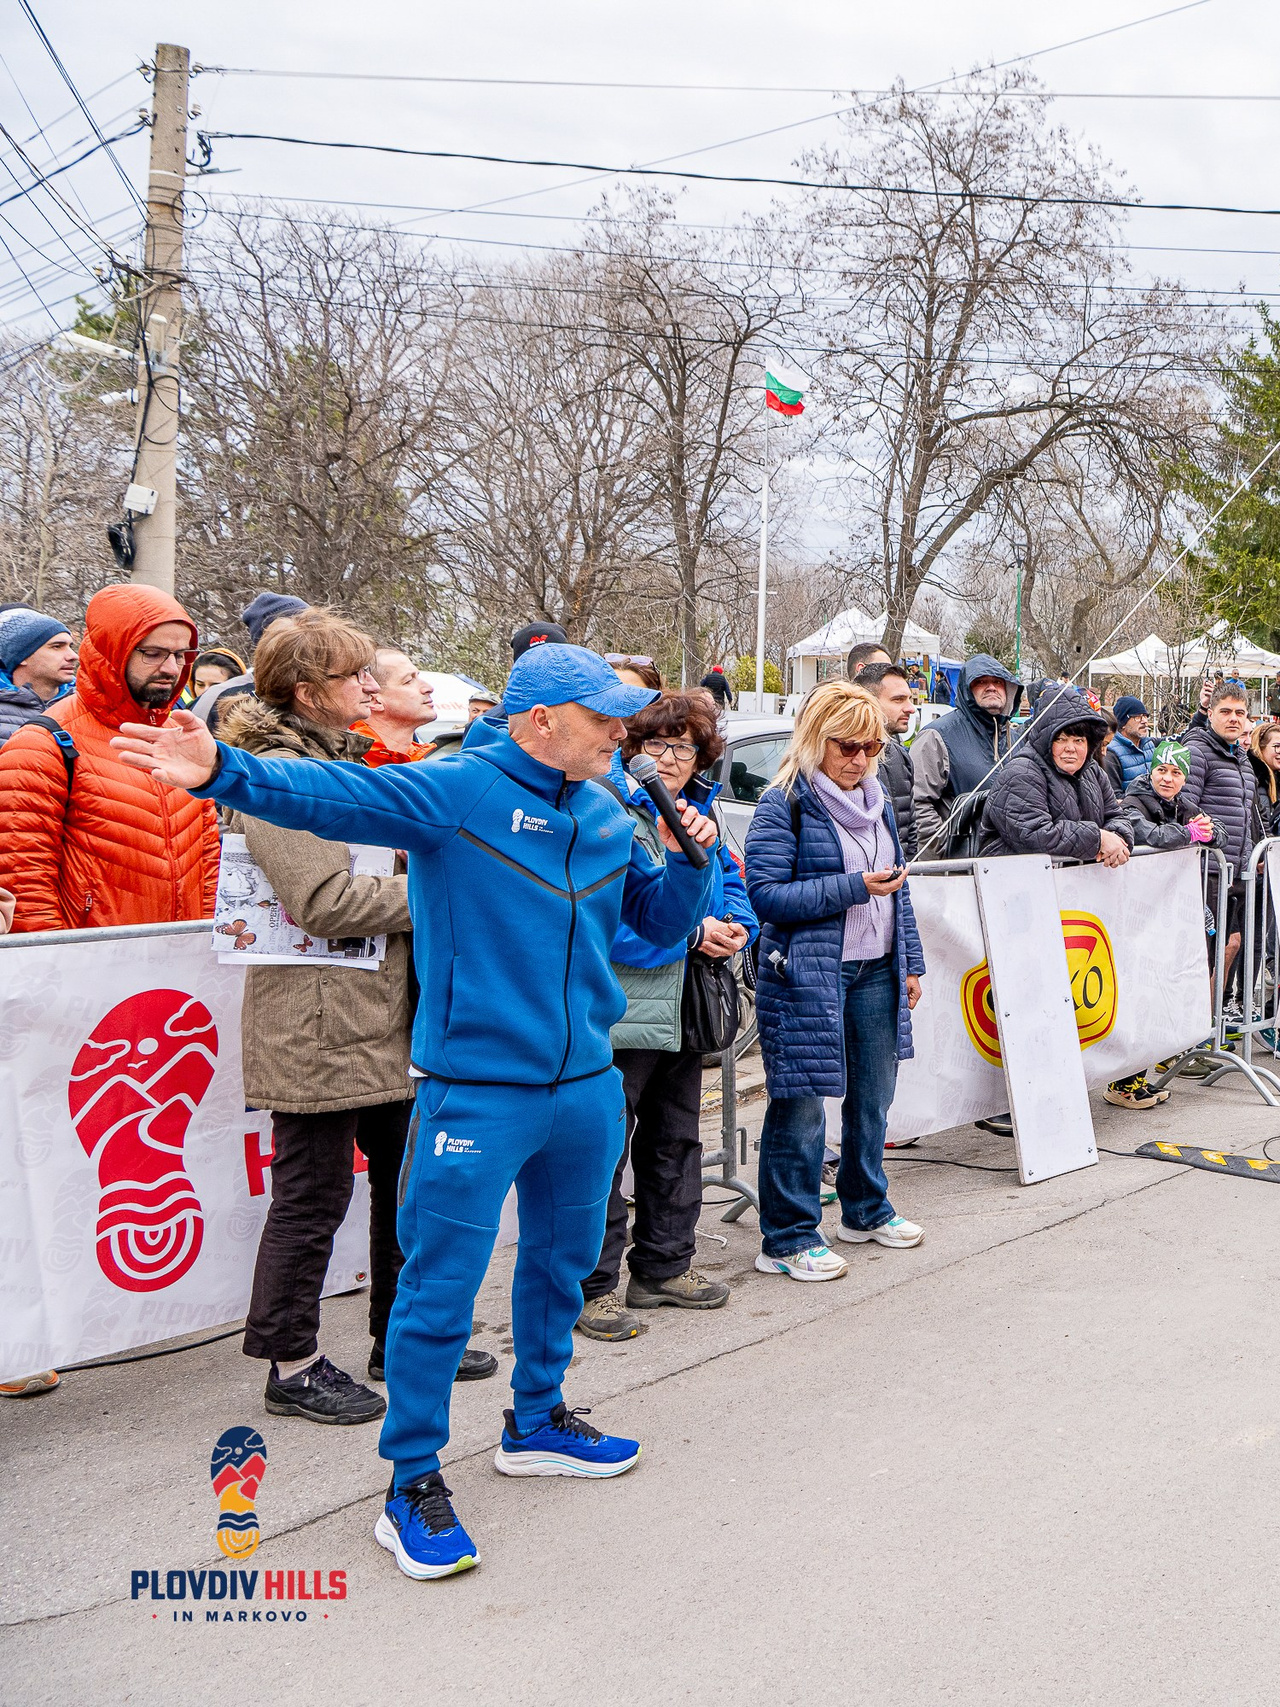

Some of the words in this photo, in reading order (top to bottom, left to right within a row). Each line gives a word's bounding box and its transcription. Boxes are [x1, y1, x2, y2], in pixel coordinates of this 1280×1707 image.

[524, 815, 548, 826] PLOVDIV
[522, 822, 540, 831] HILLS
[447, 1138, 474, 1147] PLOVDIV
[446, 1145, 464, 1153] HILLS
